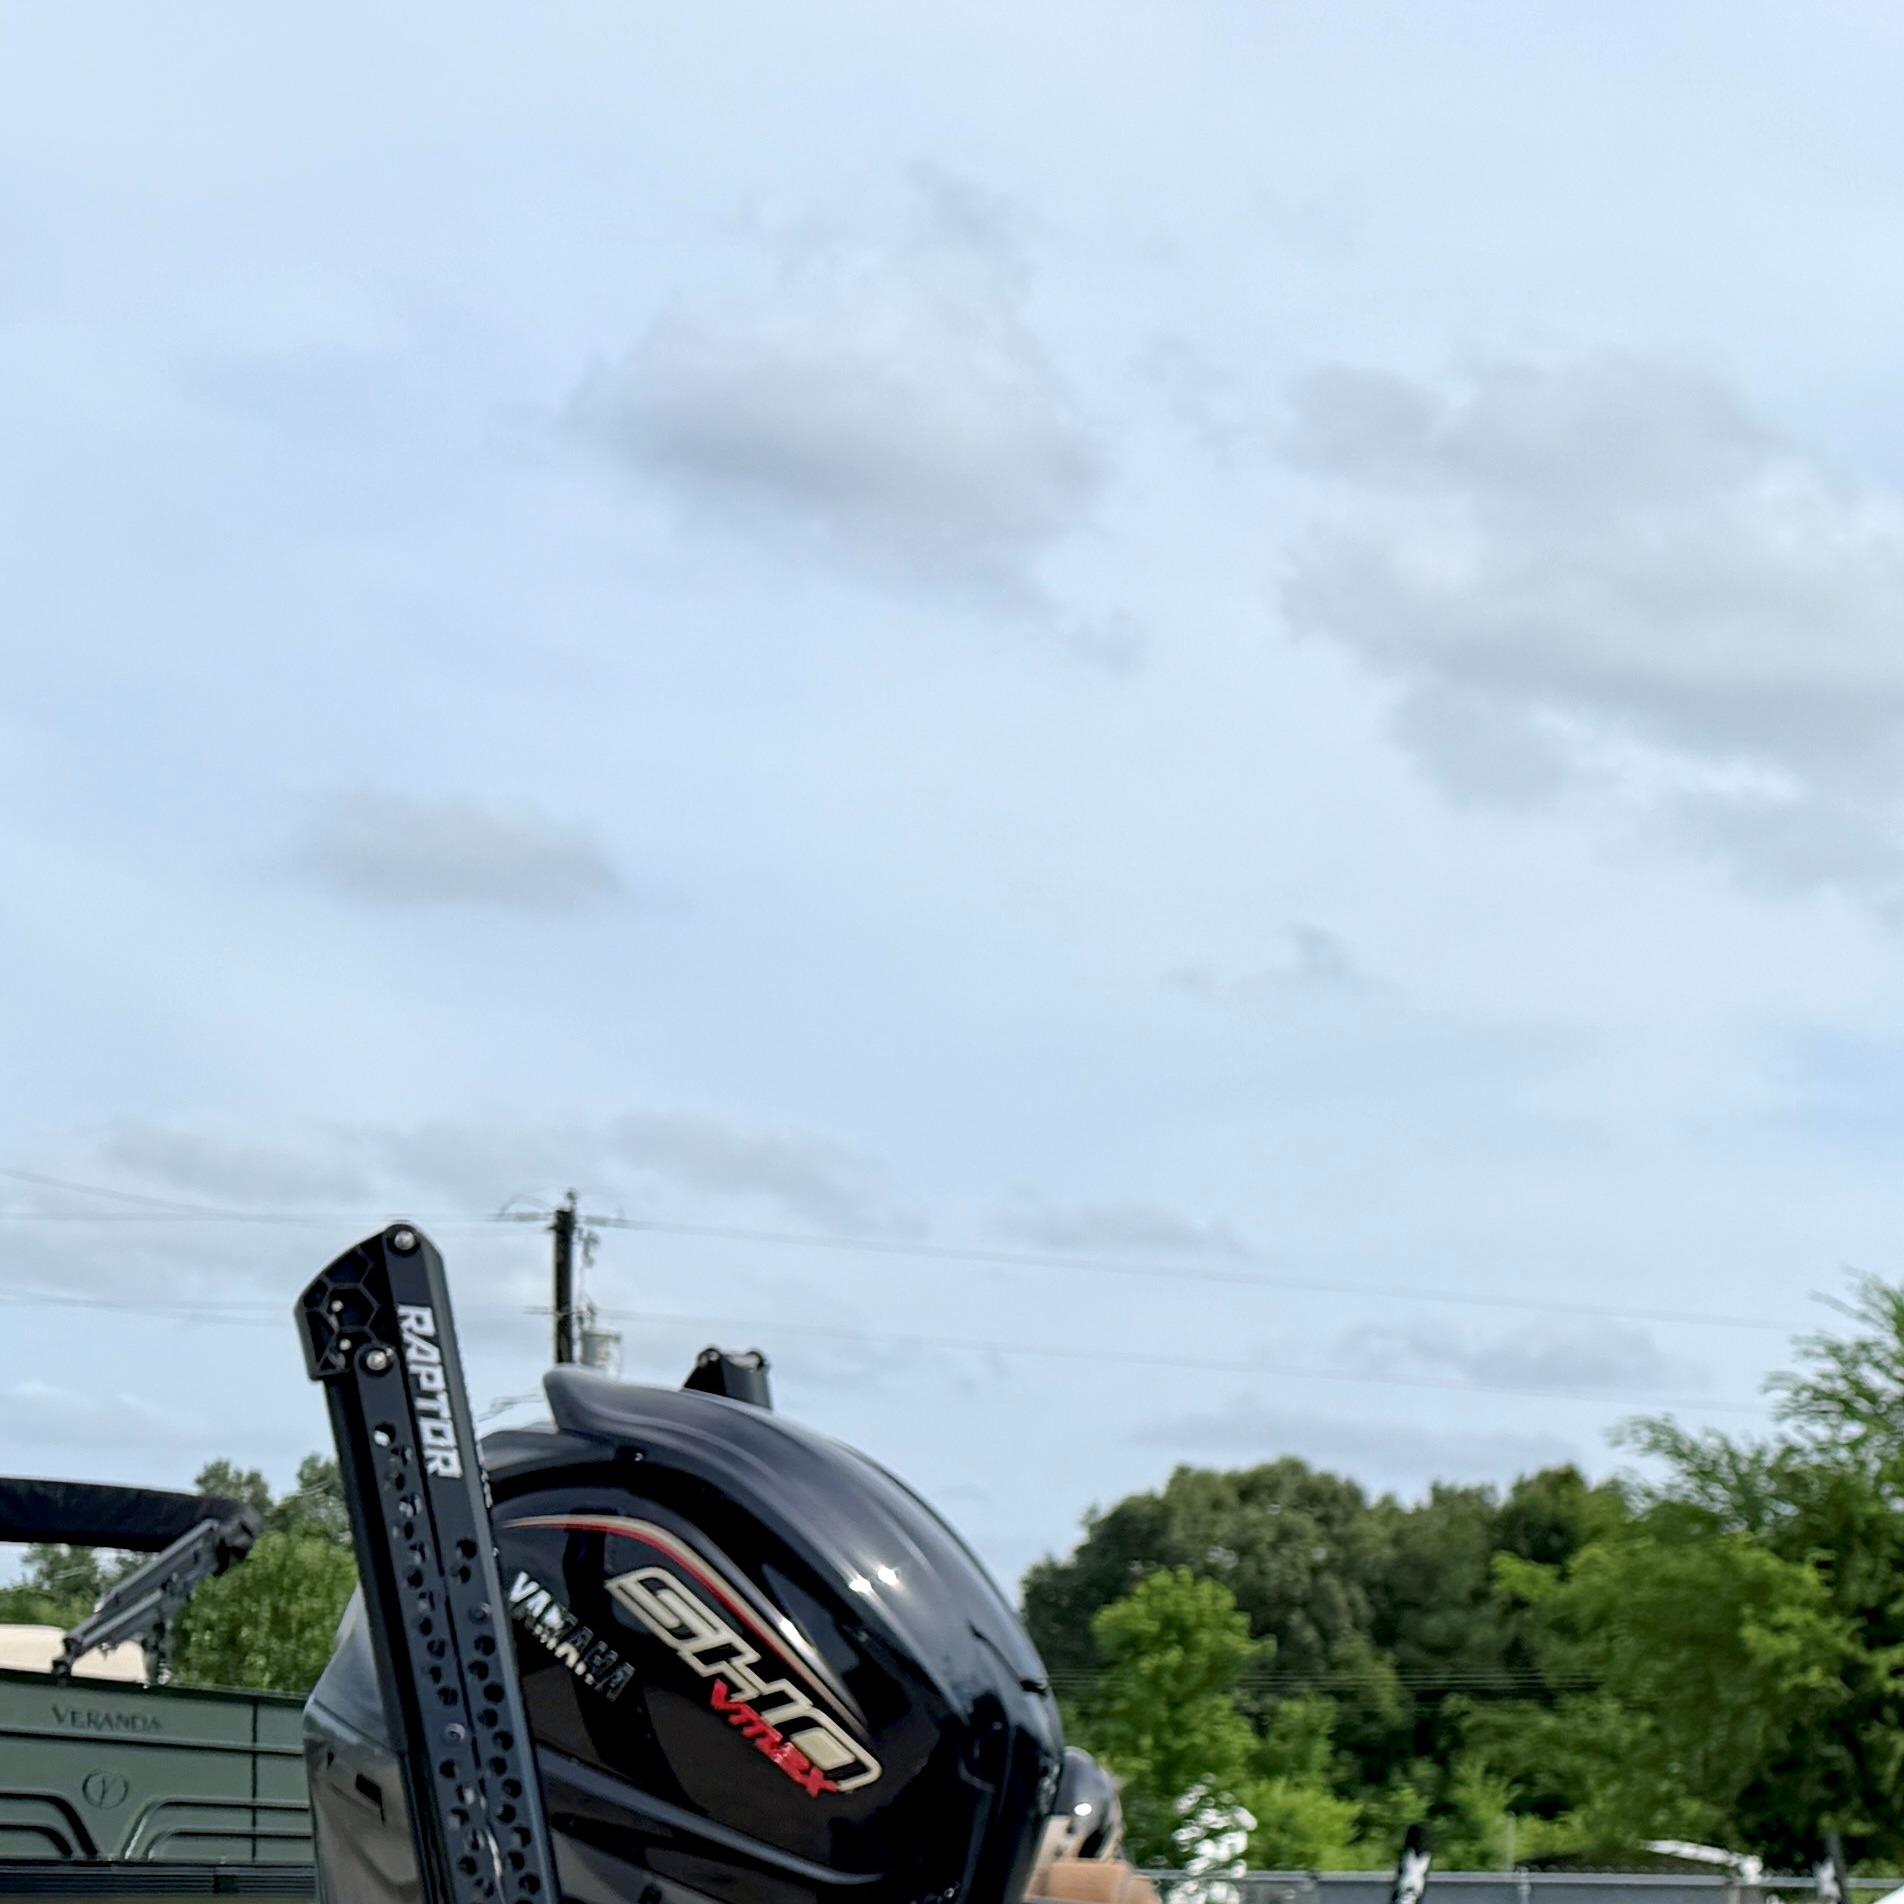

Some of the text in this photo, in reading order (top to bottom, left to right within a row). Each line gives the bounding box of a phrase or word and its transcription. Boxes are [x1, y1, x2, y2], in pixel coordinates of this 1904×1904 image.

[398, 1303, 463, 1479] RAPTOR
[509, 1570, 635, 1702] YAMAHA
[603, 1566, 883, 1793] SHO
[51, 1705, 161, 1732] VERANDA
